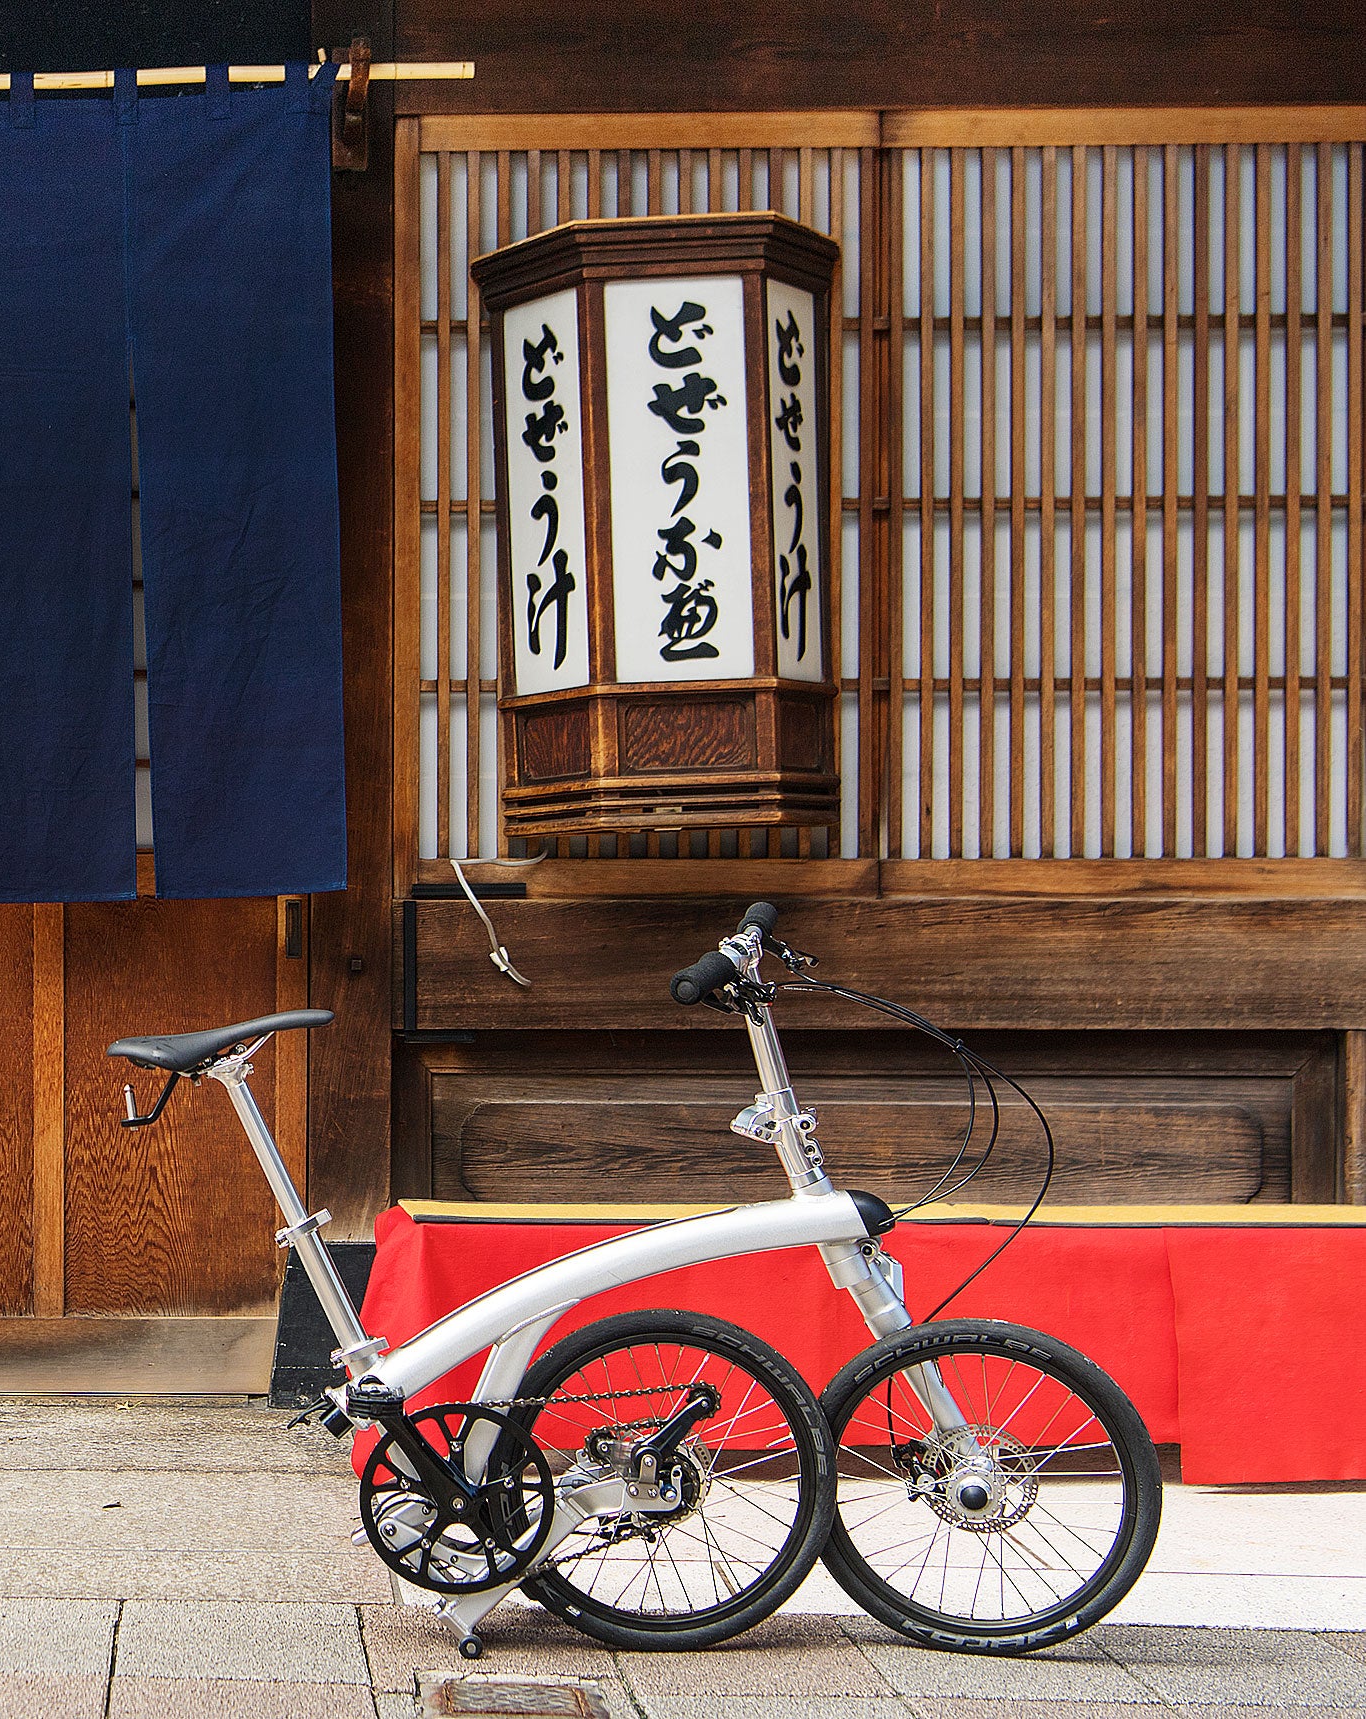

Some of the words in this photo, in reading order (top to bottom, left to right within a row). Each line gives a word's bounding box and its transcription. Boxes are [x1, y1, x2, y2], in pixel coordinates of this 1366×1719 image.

[521, 323, 576, 670] どぜう汁
[774, 310, 813, 662] どぜう汁
[692, 1326, 828, 1477] SCHWALBE
[853, 1334, 1054, 1385] SCHWALBE
[902, 1619, 1059, 1648] KOJAK
